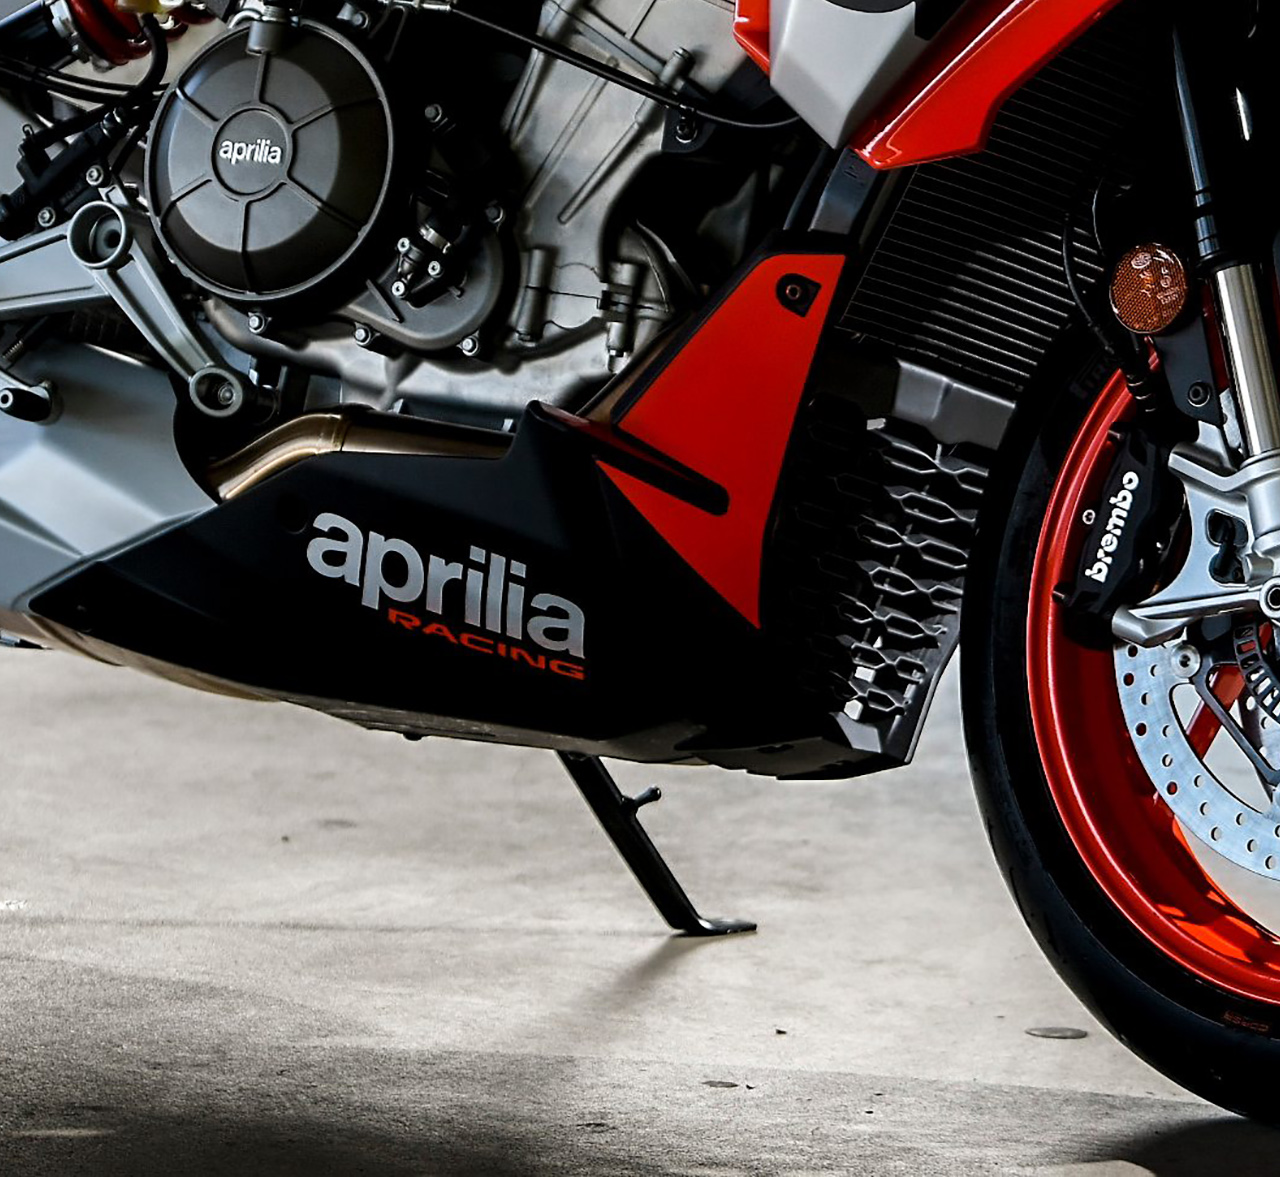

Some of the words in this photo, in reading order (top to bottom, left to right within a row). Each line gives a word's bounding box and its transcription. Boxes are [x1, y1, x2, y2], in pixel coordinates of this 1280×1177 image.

[219, 138, 282, 166] aprilia
[1084, 470, 1140, 584] brembo
[306, 512, 586, 660] aprilia
[387, 607, 586, 681] RACING
